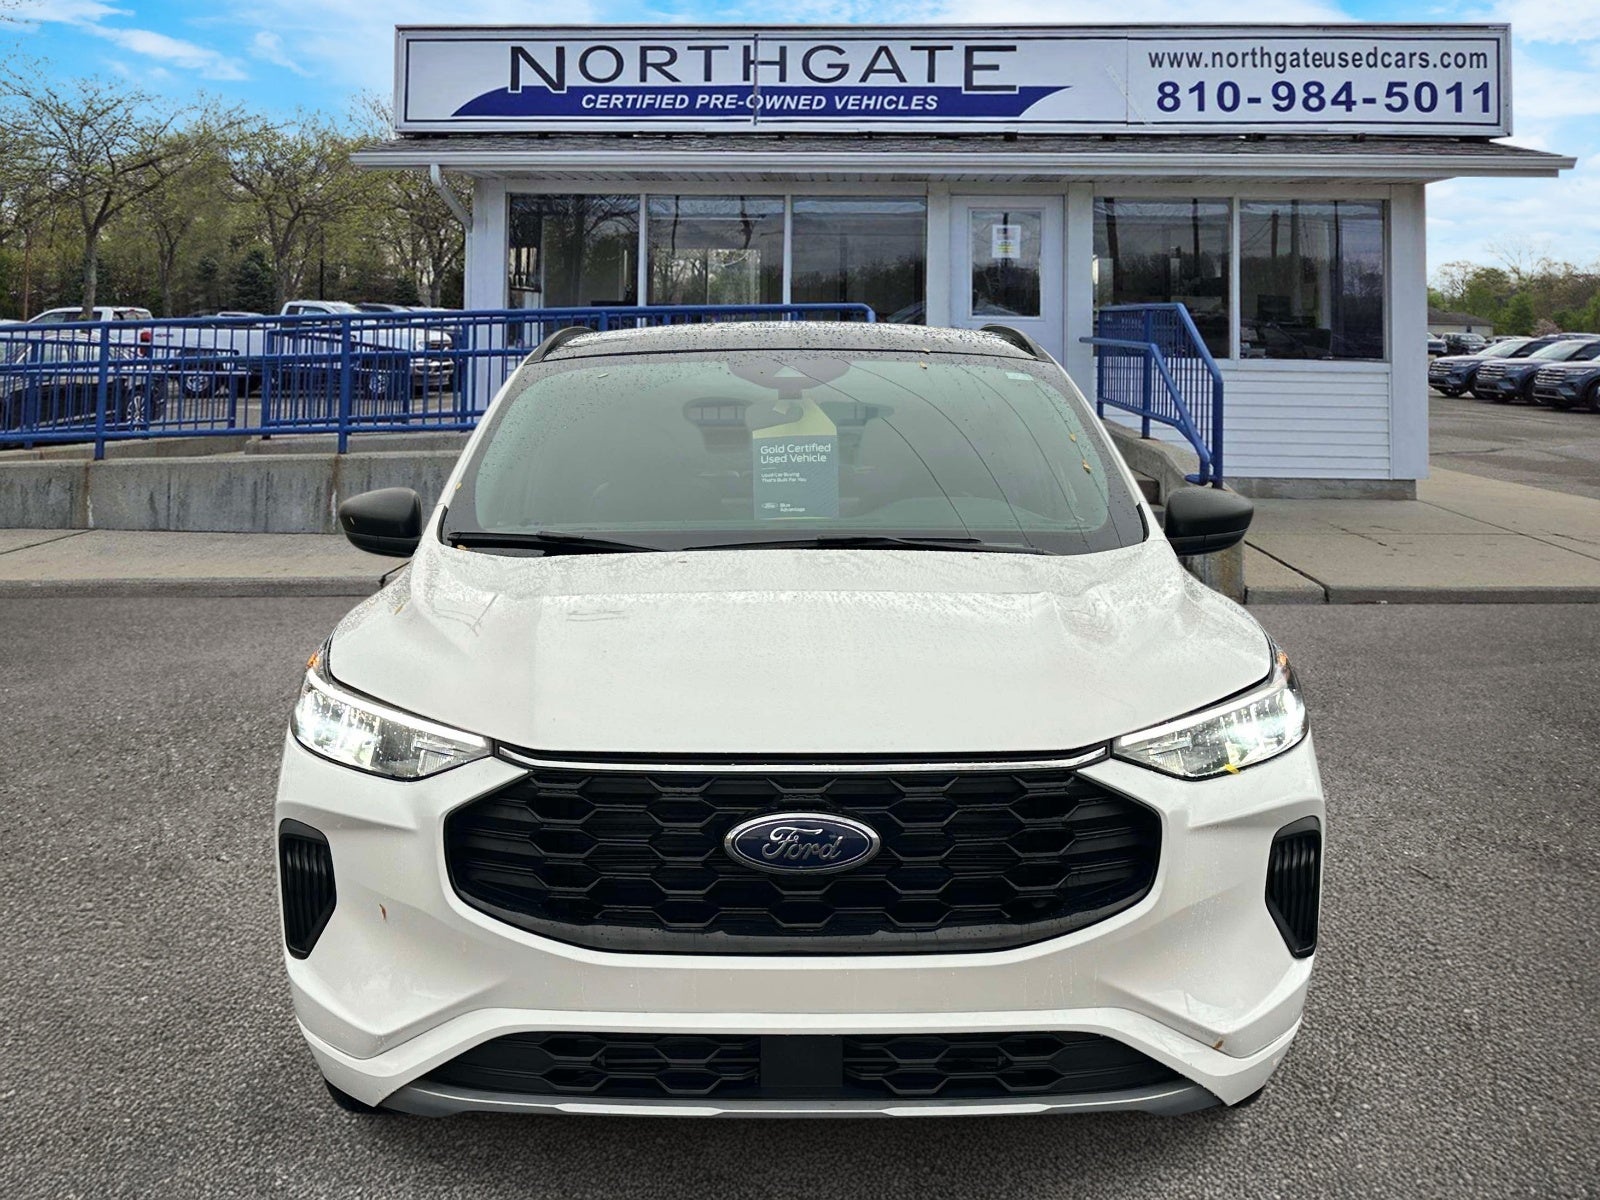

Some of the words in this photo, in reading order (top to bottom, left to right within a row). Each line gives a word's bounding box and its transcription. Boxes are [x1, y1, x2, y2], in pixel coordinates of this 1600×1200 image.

[509, 44, 1017, 92] NORTHGATE
[1148, 46, 1488, 73] www.northgateusedcars.com
[581, 94, 690, 110] CERTIFIED
[695, 94, 827, 110] PRE-OWNED
[834, 95, 939, 111] VEHICLES
[1156, 81, 1491, 114] 810-984-5011
[760, 445, 785, 454] Gold
[787, 443, 831, 453] Certified
[760, 454, 788, 464] Used
[789, 453, 827, 463] Vehicle
[761, 826, 844, 860] Ford
